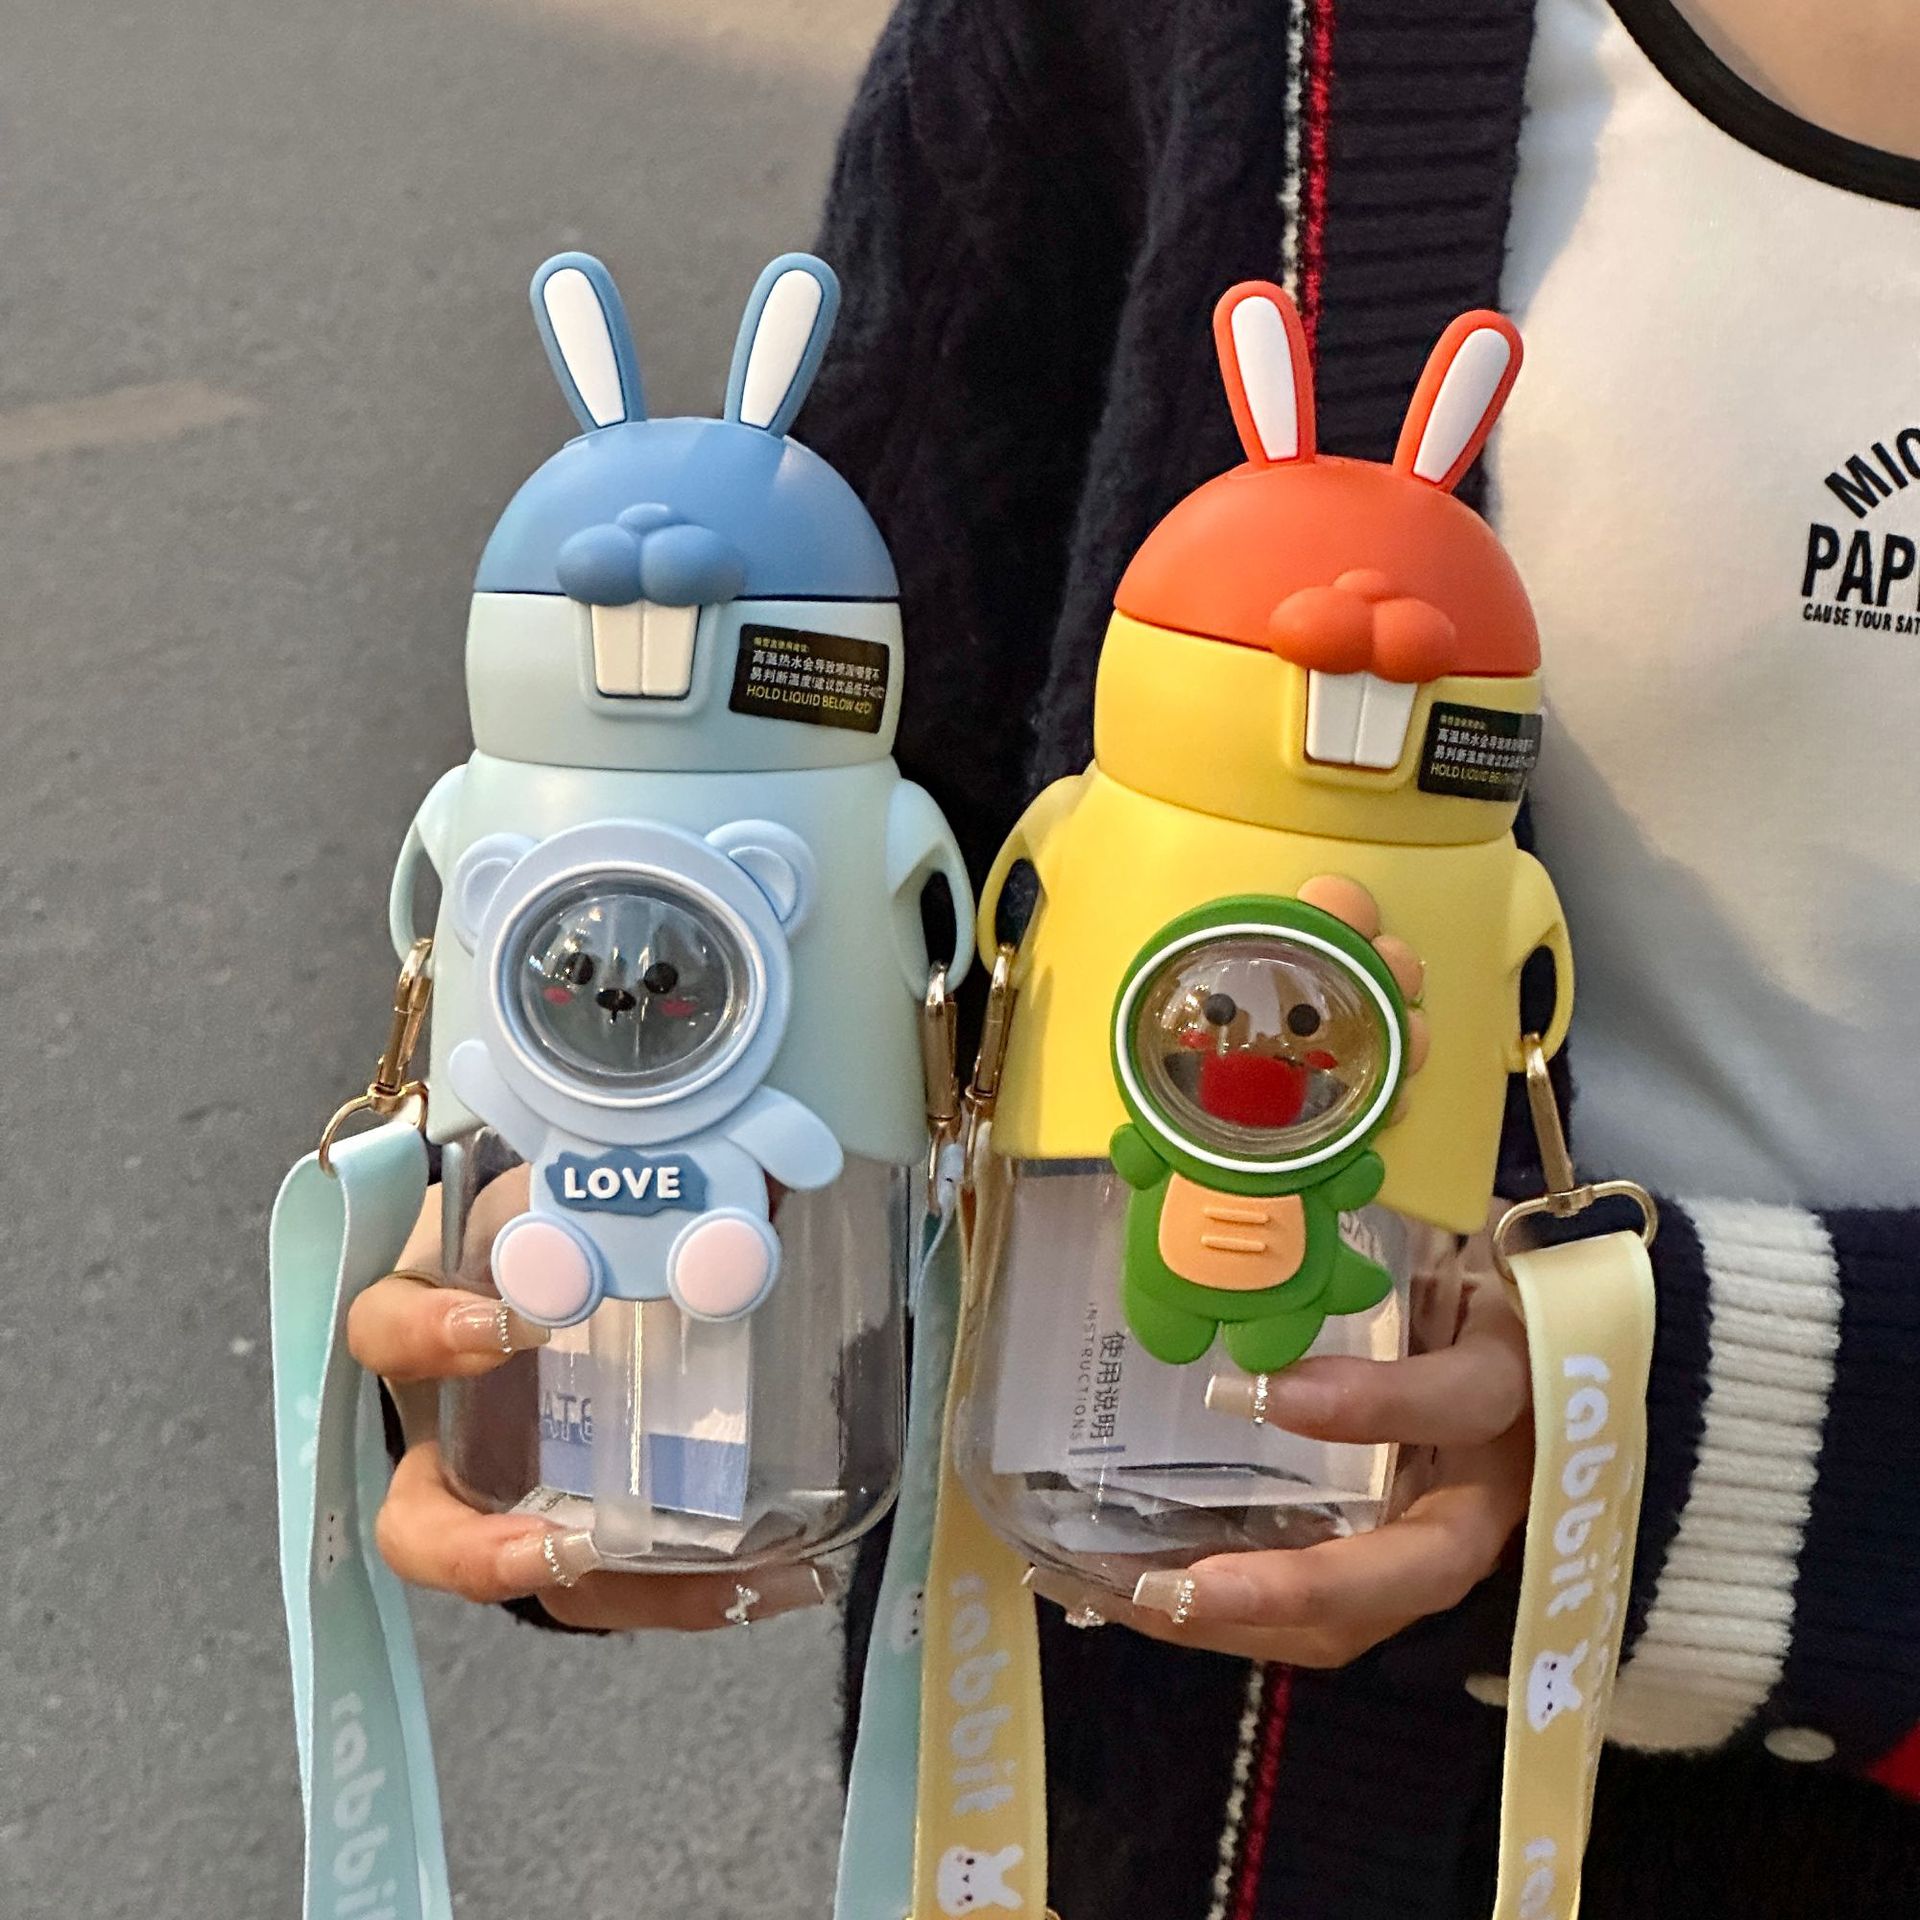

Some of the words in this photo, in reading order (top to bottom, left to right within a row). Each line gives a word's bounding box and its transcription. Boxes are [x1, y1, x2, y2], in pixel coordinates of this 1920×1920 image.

[1801, 523, 1920, 613] PAP
[1803, 603, 1851, 626] CAUSE
[1855, 609, 1892, 631] YOUR
[746, 685, 781, 700] HOLD
[782, 690, 820, 707] LIQUID
[822, 695, 853, 711] BELOW
[1430, 762, 1460, 778] HOLD
[564, 1167, 681, 1199] LOVE
[1090, 1331, 1125, 1439] 使用说明
[1547, 1354, 1617, 1617] rabbit
[951, 1572, 1016, 1816] rabbit
[1519, 1836, 1557, 1920] ra
